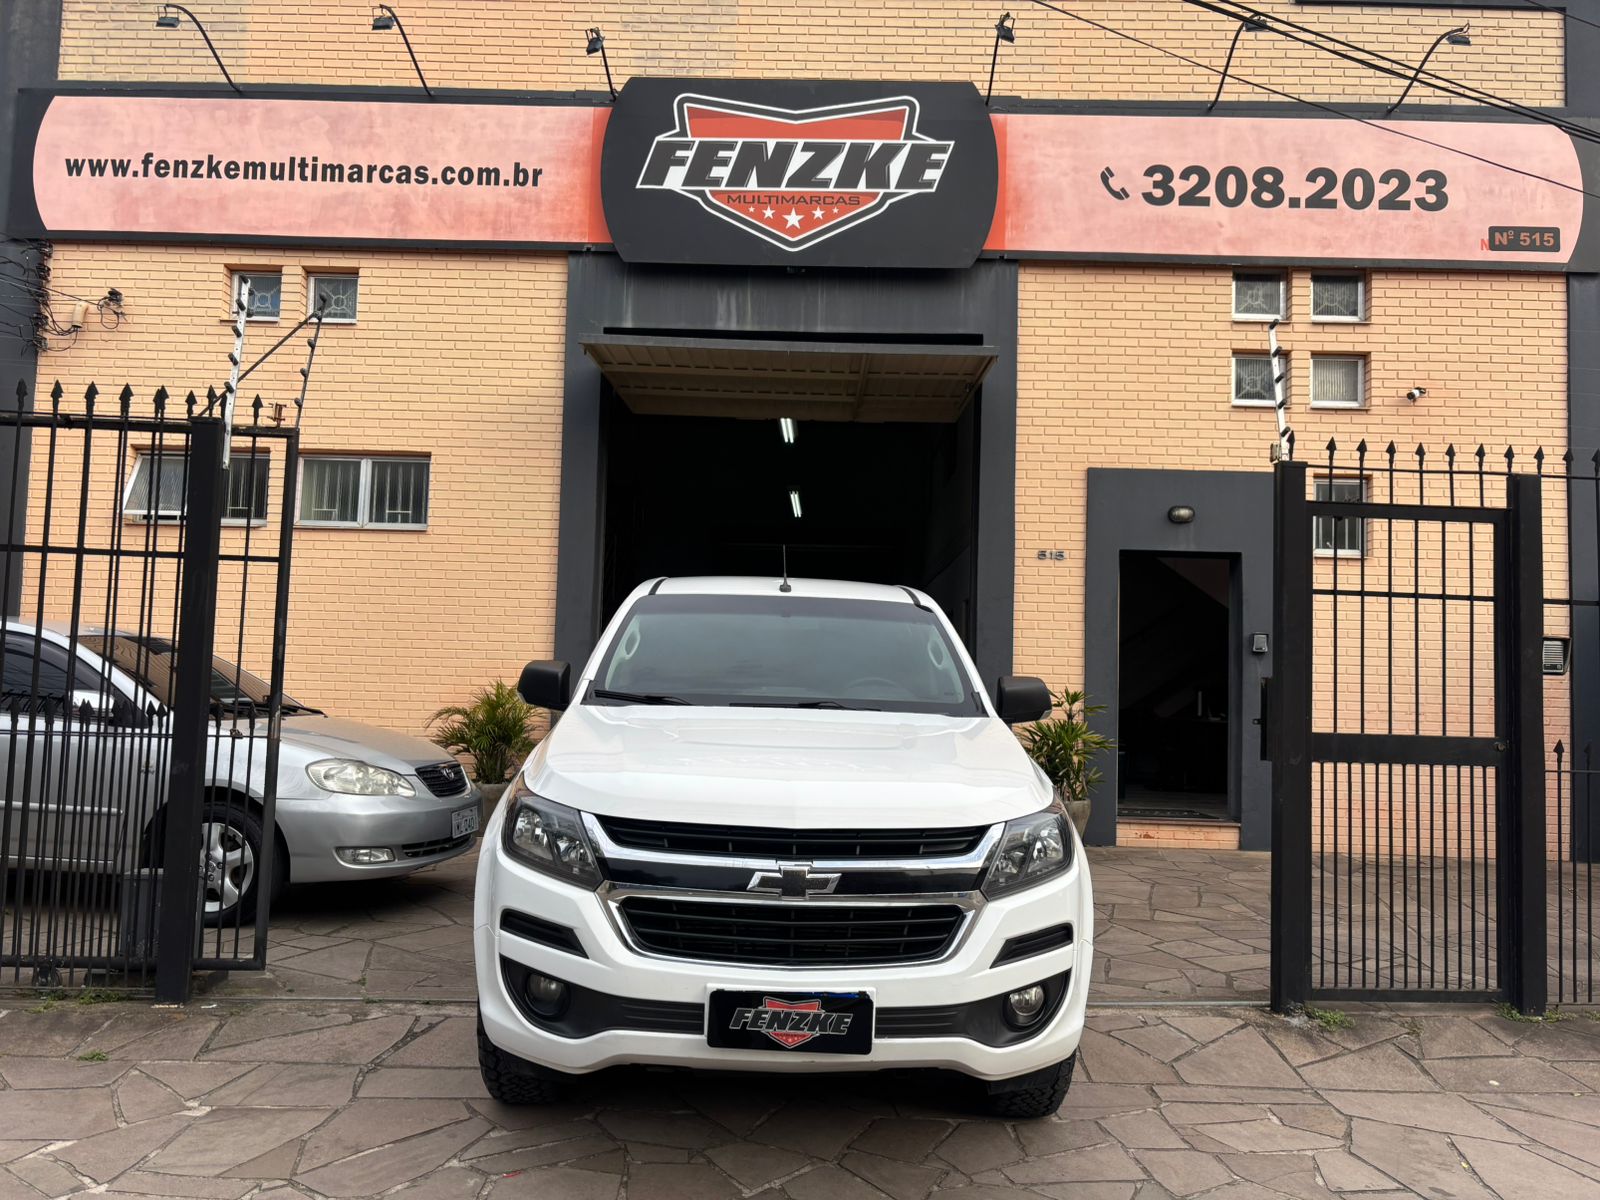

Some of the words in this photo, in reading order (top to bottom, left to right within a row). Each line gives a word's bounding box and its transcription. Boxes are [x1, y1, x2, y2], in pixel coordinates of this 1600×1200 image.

[65, 153, 543, 187] www.fenzkemultimarcas.com.br
[636, 138, 955, 192] FENZKE
[727, 195, 860, 206] MULTIMARCAS
[1141, 164, 1449, 212] 3208.2023
[1519, 232, 1555, 246] 515
[1038, 550, 1065, 561] 515
[730, 1008, 852, 1035] FENZKE
